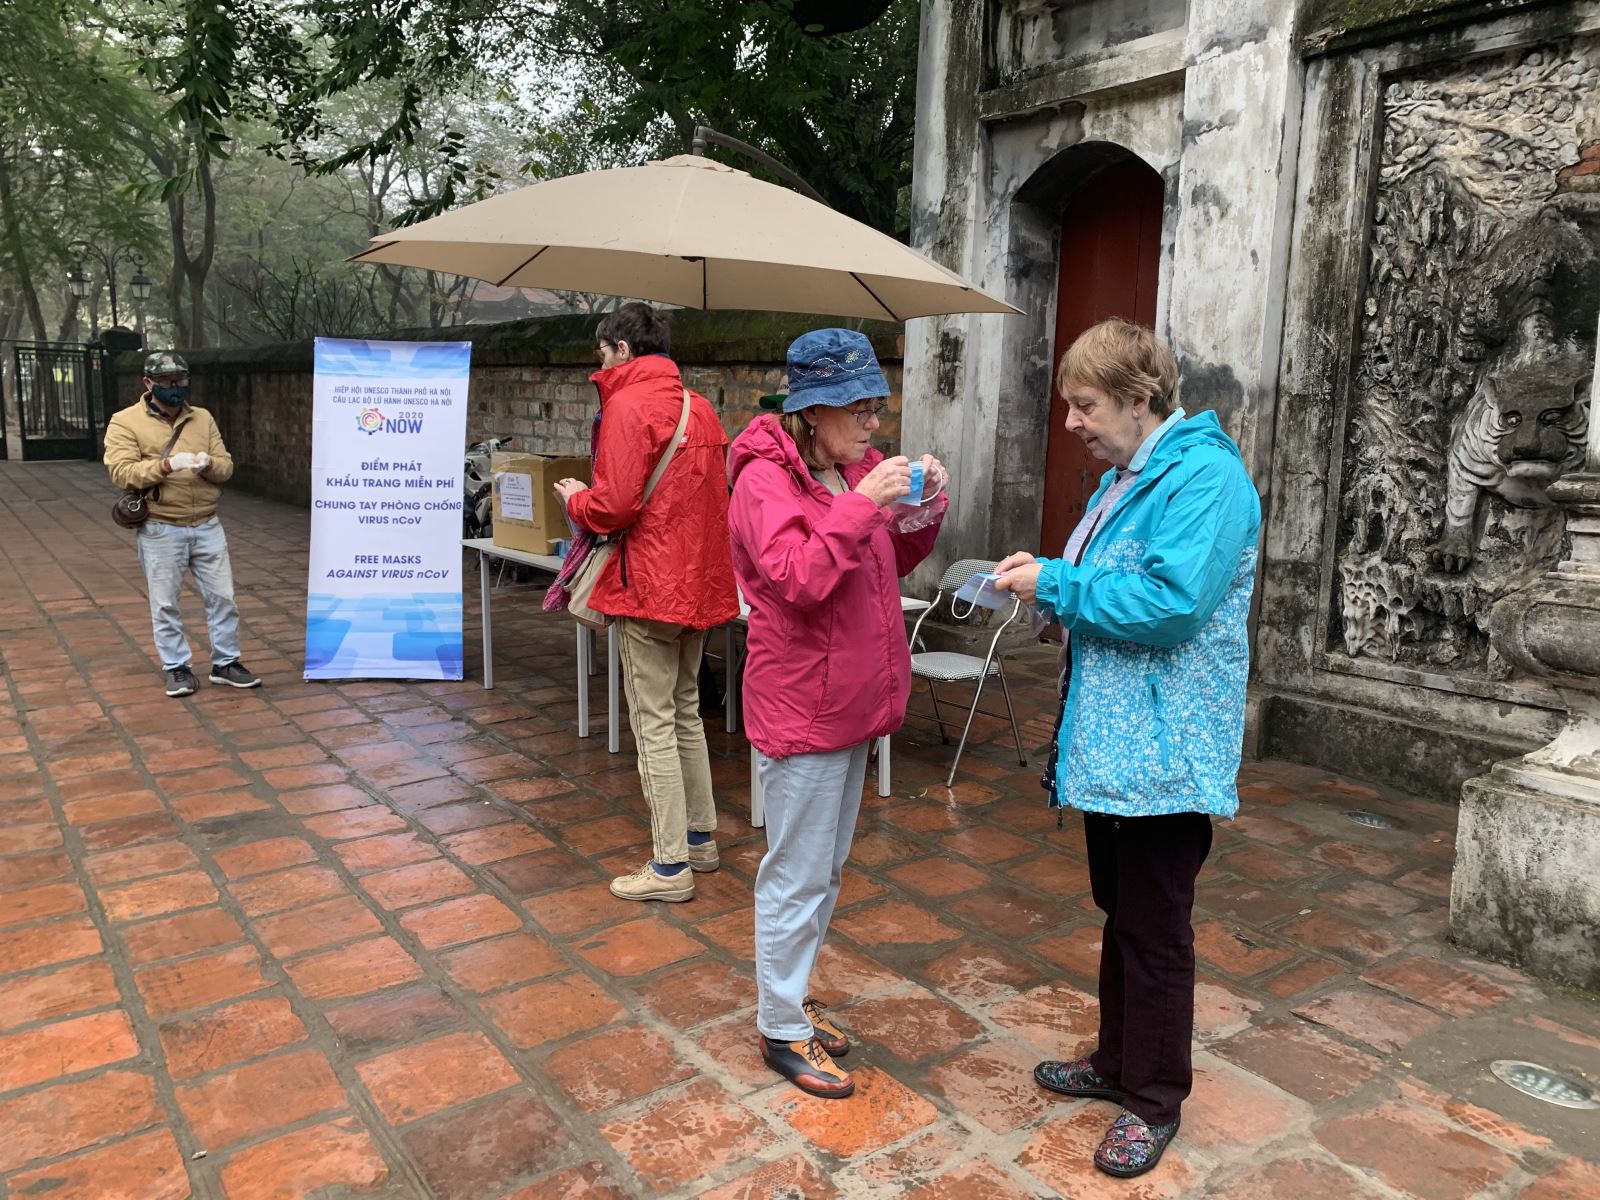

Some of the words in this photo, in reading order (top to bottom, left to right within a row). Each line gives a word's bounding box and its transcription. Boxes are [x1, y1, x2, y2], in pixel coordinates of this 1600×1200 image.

[364, 386, 389, 394] UNESCO
[404, 398, 428, 406] UNESCO
[386, 418, 423, 434] NOW
[361, 457, 389, 471] ĐIỂM
[393, 460, 422, 471] PHÁT
[326, 474, 359, 488] KHẨU
[362, 478, 401, 488] TRANG
[405, 476, 432, 488] MIỄN
[436, 477, 454, 488] PHÍ
[315, 500, 356, 510] CHUNG
[360, 501, 377, 510] TAY
[381, 500, 421, 510] PHÒNG
[424, 499, 462, 510] CHỐNG
[358, 516, 389, 524] VIRUS
[392, 516, 422, 525] nCoV
[354, 555, 379, 564] FREE
[382, 555, 422, 564] MASKS
[326, 569, 378, 578] AGAINST
[382, 570, 414, 579] VIRUS
[416, 570, 449, 579] nCoV
